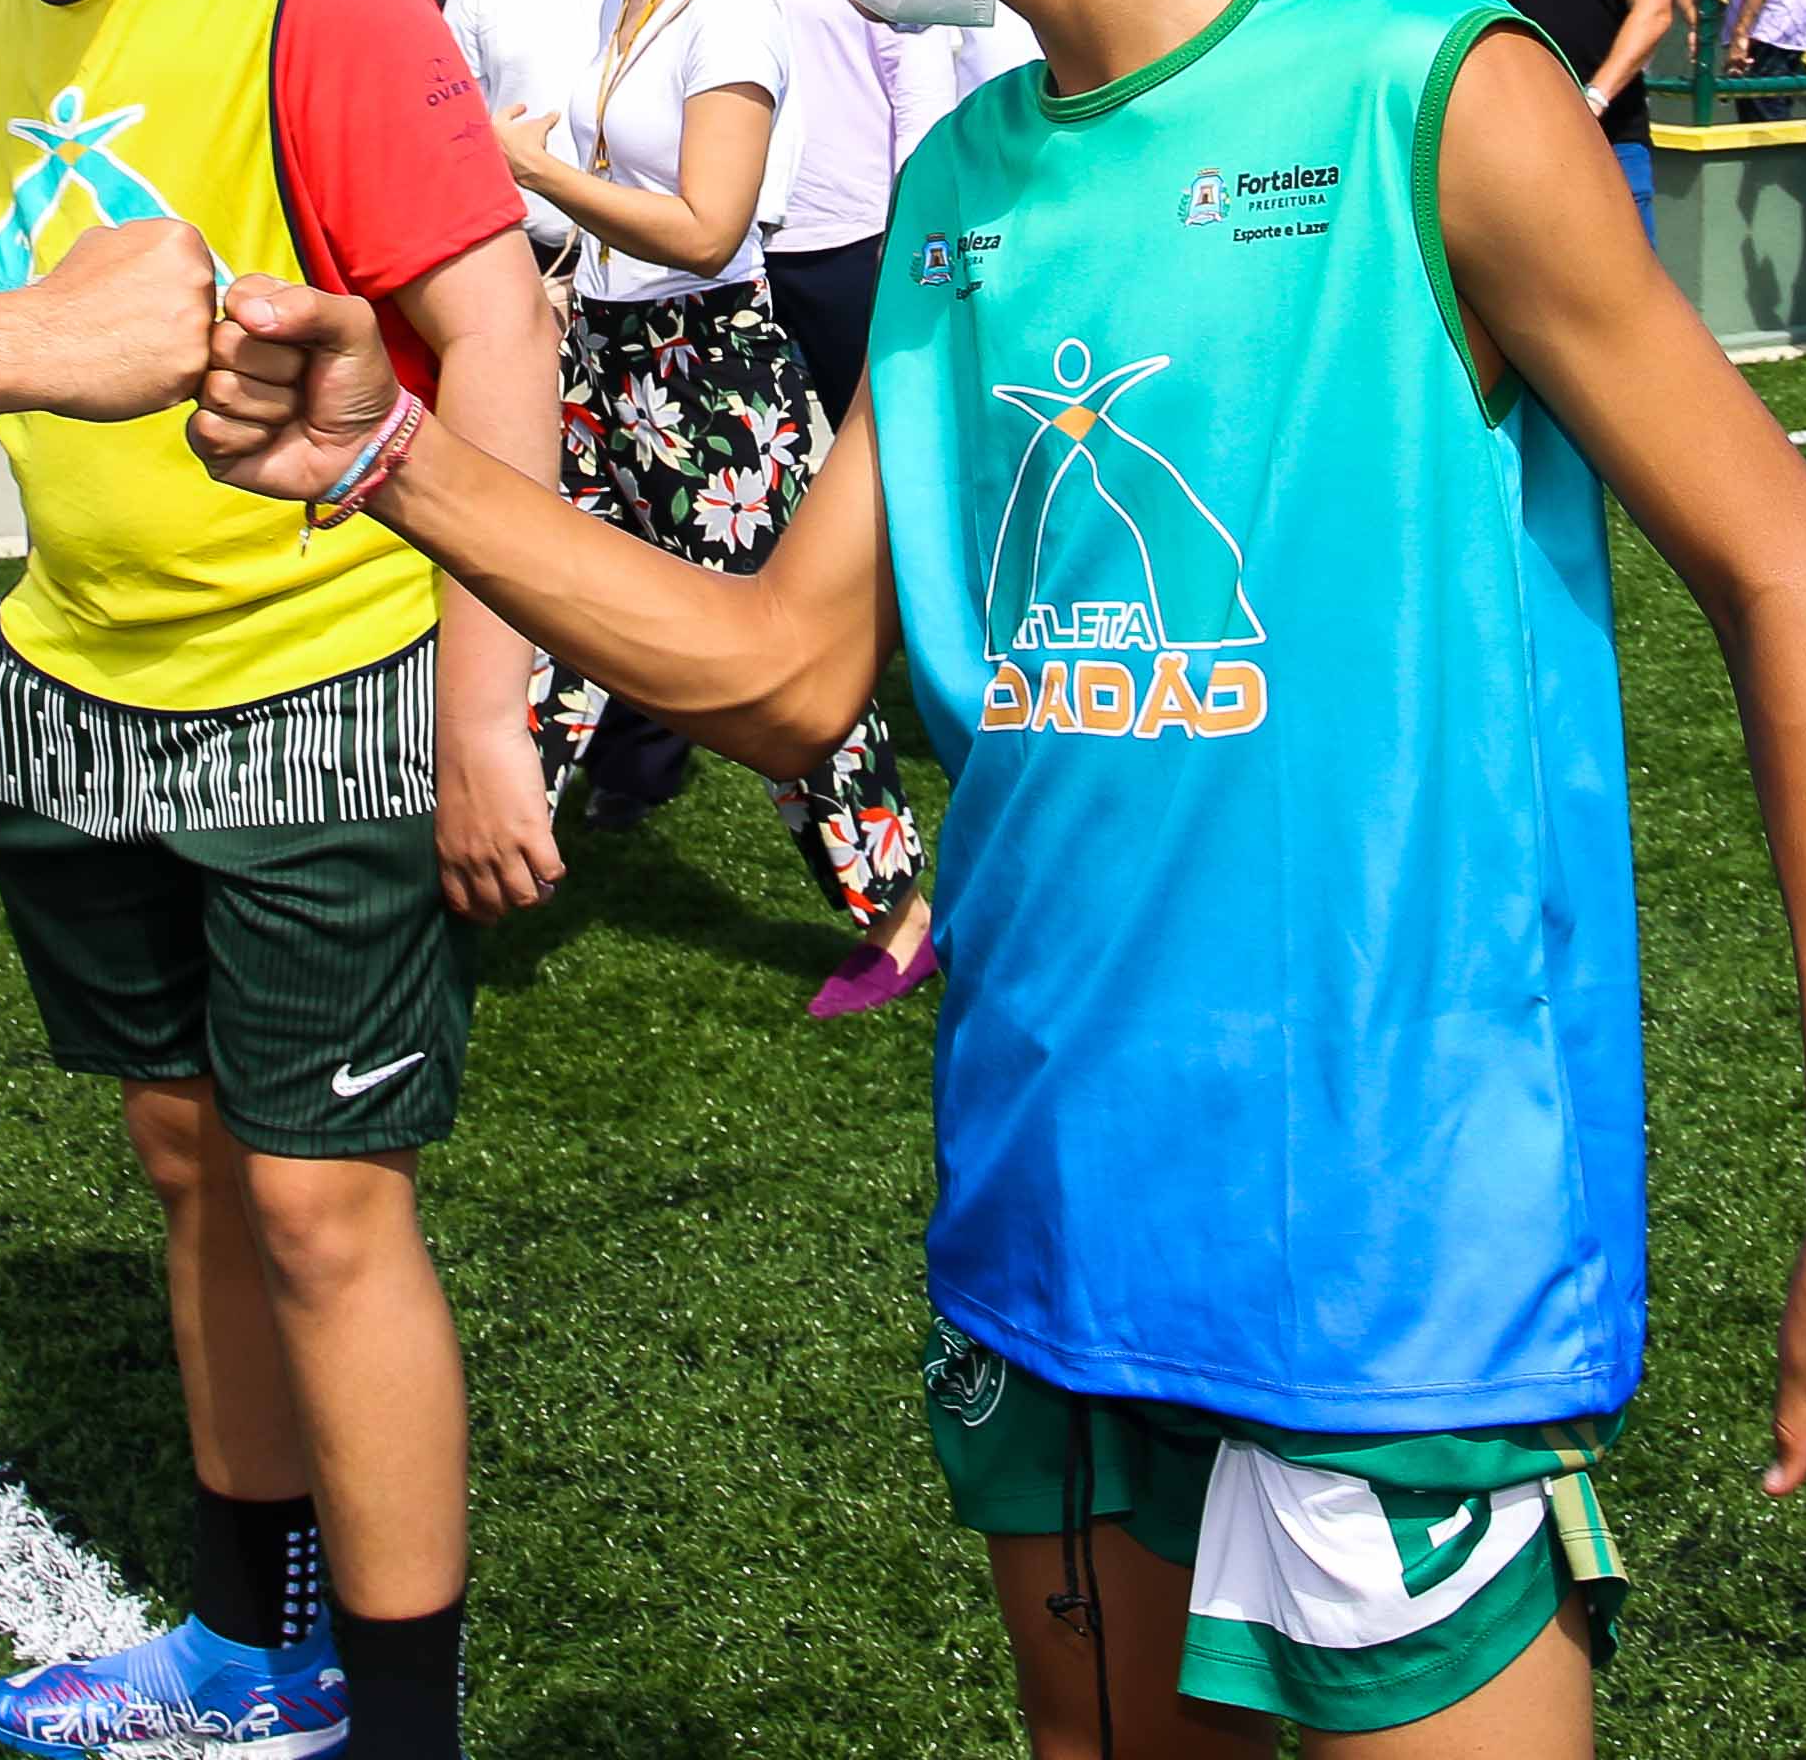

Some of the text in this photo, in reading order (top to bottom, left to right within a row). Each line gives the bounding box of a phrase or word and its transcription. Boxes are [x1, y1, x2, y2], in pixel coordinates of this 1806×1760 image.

[426, 80, 471, 107] OVER
[1236, 164, 1339, 198] Fortaleza
[1248, 193, 1327, 213] PREFEITURA
[1233, 225, 1282, 244] Esporte
[1284, 225, 1294, 236] e
